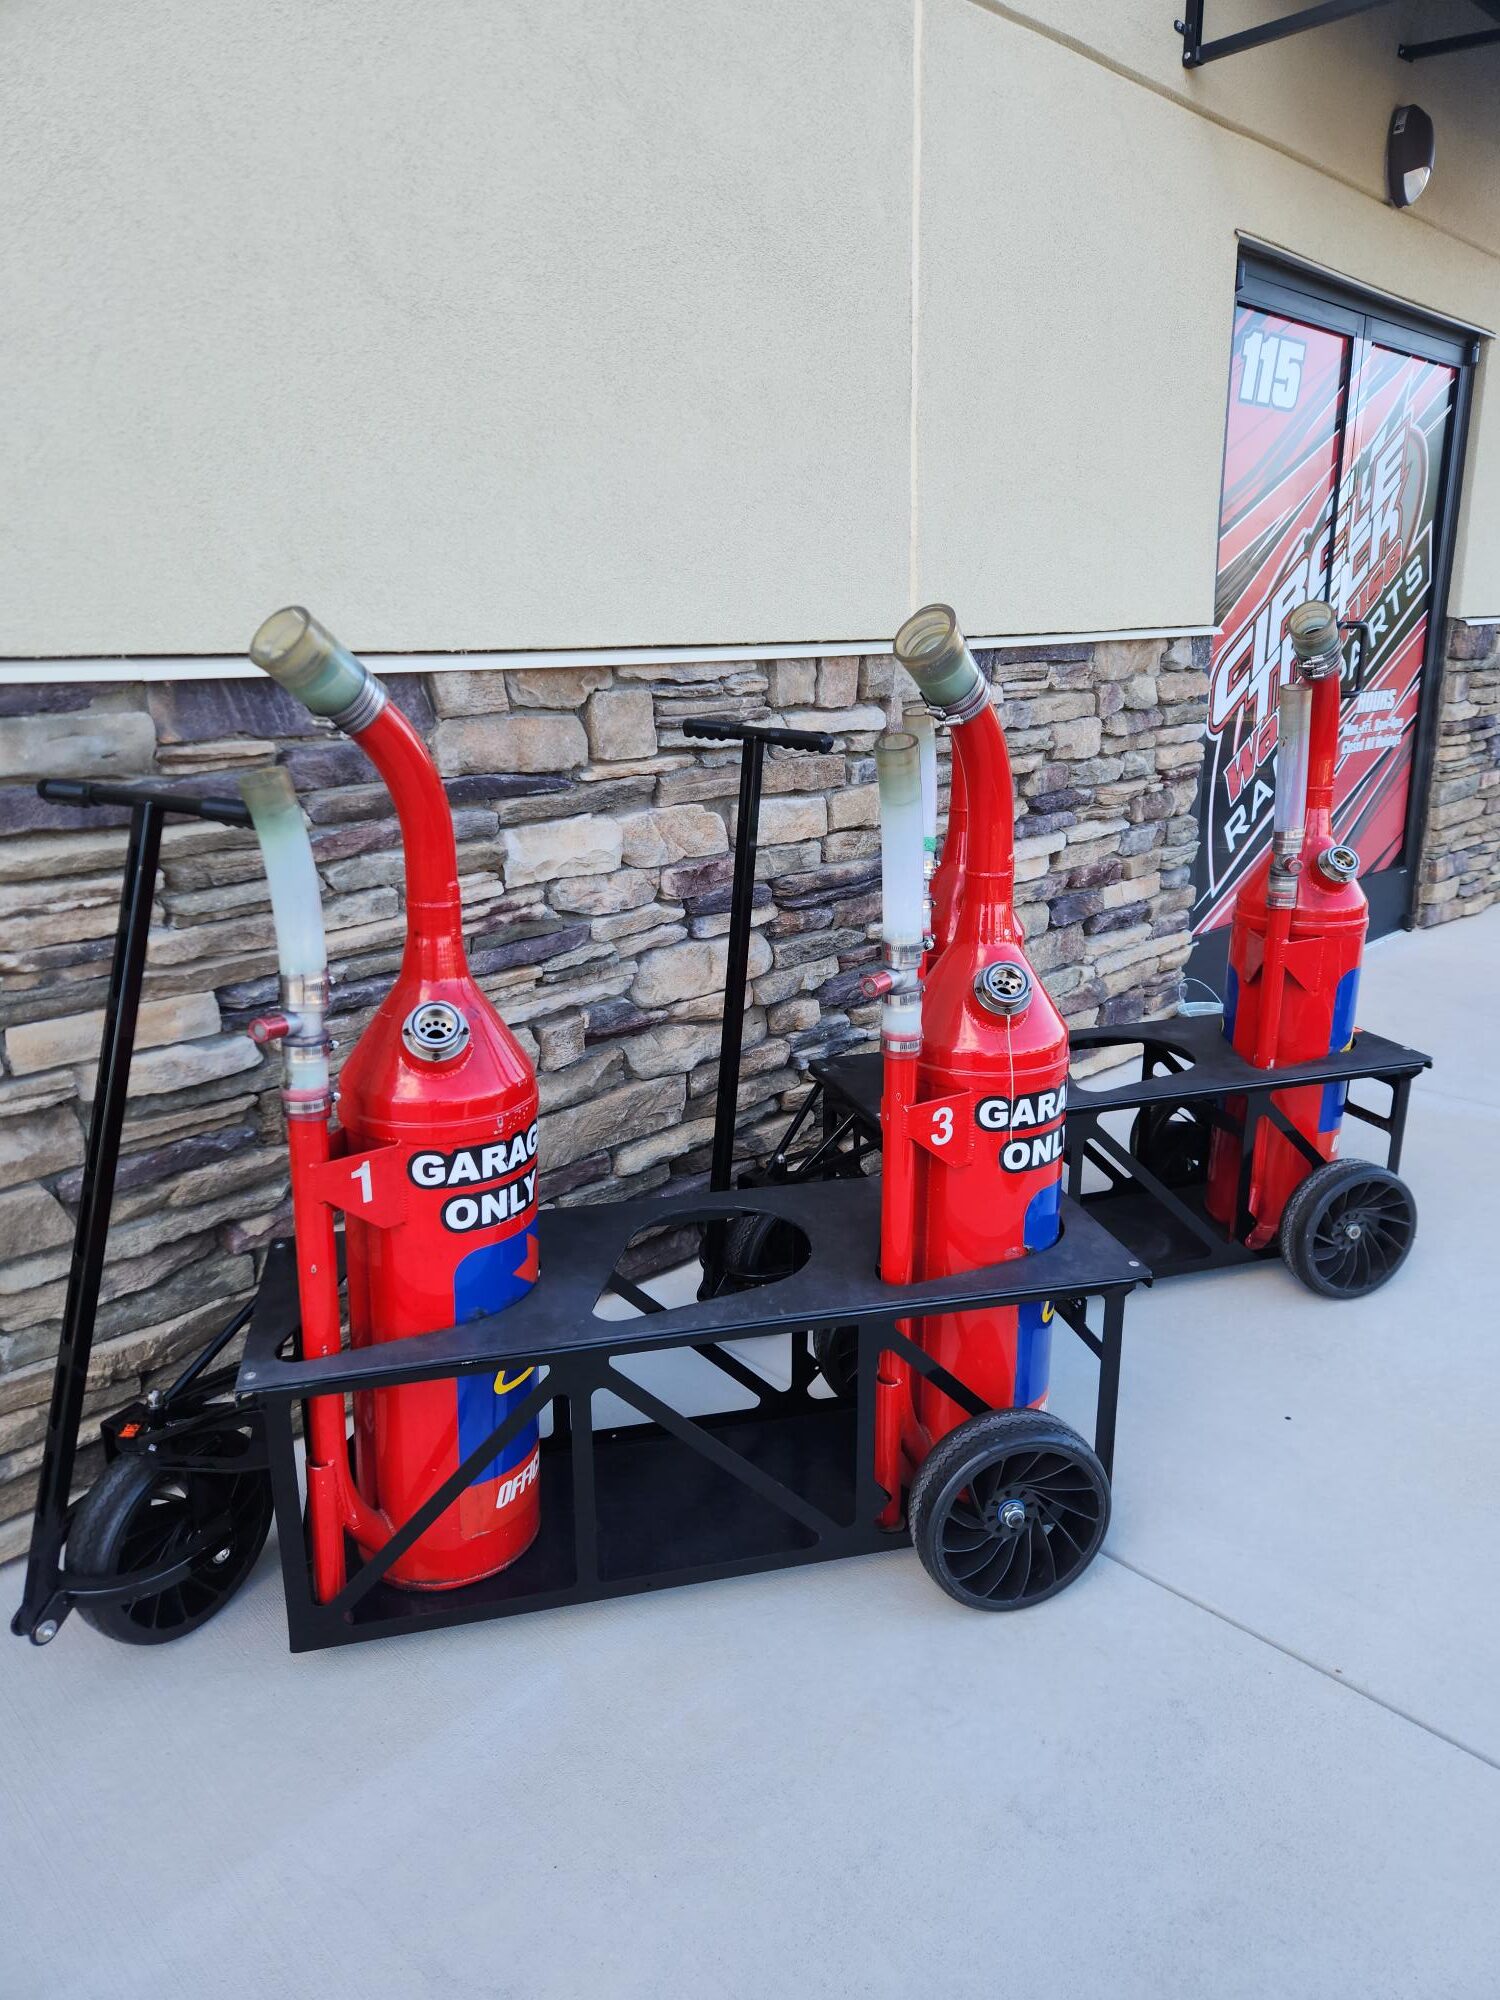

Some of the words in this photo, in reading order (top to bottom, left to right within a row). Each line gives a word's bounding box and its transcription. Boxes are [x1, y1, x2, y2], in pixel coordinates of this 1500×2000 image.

[1239, 331, 1306, 409] 115
[1210, 422, 1408, 728] CIRCLE
[930, 1106, 954, 1146] 3
[1003, 1125, 1066, 1170] ONL
[351, 1160, 373, 1203] 1
[445, 1168, 536, 1230] ONLY
